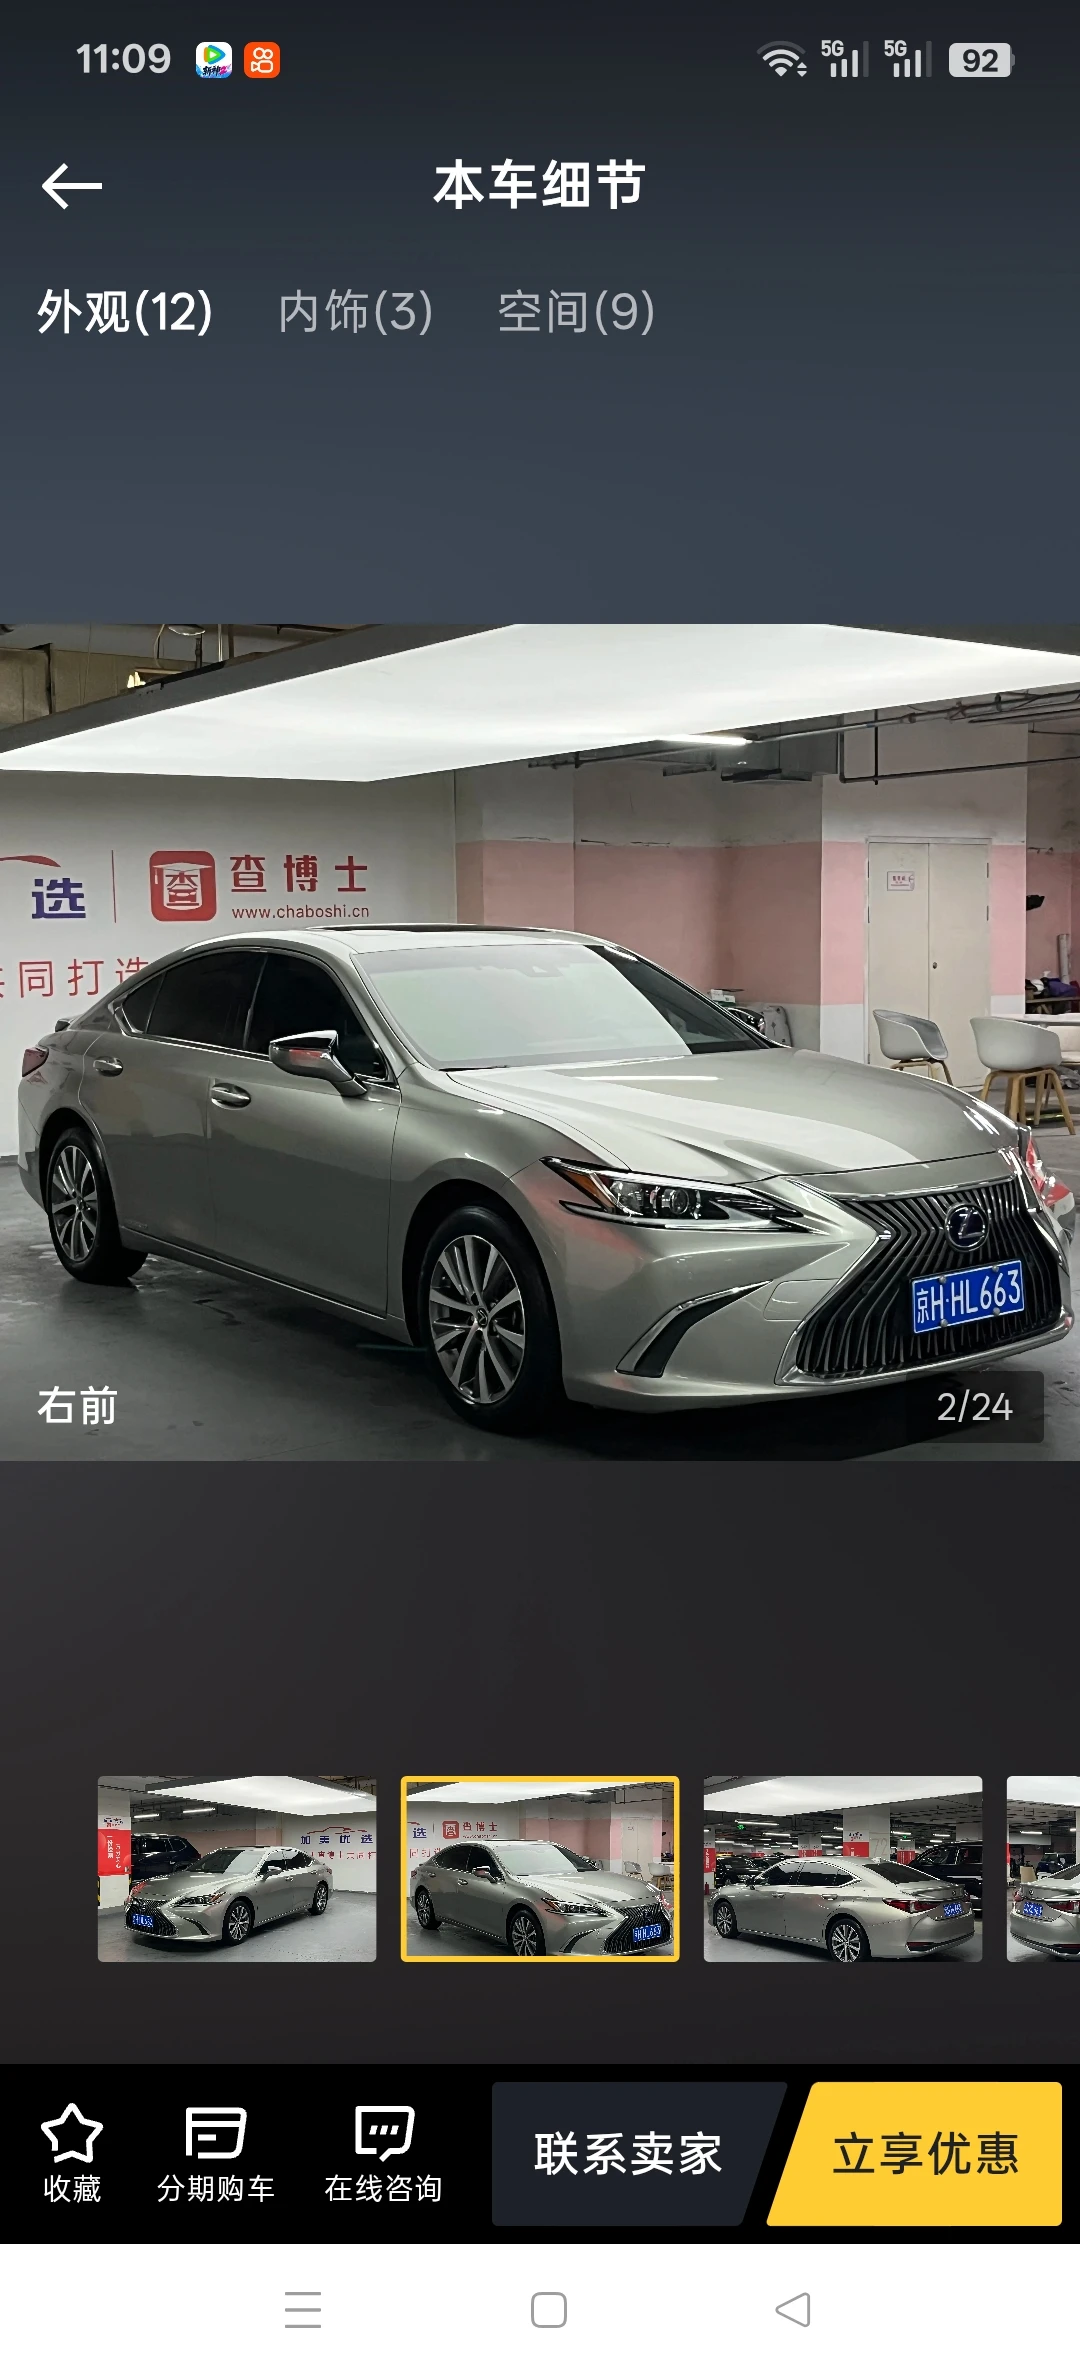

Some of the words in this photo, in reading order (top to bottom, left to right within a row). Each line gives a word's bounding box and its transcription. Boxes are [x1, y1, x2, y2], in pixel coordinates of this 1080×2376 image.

[77, 43, 171, 73] 11:09
[821, 40, 844, 56] 5G
[884, 40, 907, 56] 5G
[963, 49, 998, 72] 92
[433, 158, 645, 209] 本车细节
[37, 289, 211, 336] 外观(12)
[278, 289, 432, 336] 内饰(3)
[498, 289, 654, 336] 空间(9)
[230, 855, 367, 892] 查博士
[32, 878, 86, 919] 选
[232, 904, 369, 919] www.chaboshi.cn
[534, 2131, 723, 2176] 联系卖家
[832, 2131, 1019, 2176] 立享优惠
[43, 2174, 102, 2203] 收藏
[156, 2174, 275, 2203] 分期购车
[325, 2174, 442, 2203] 在线咨询
